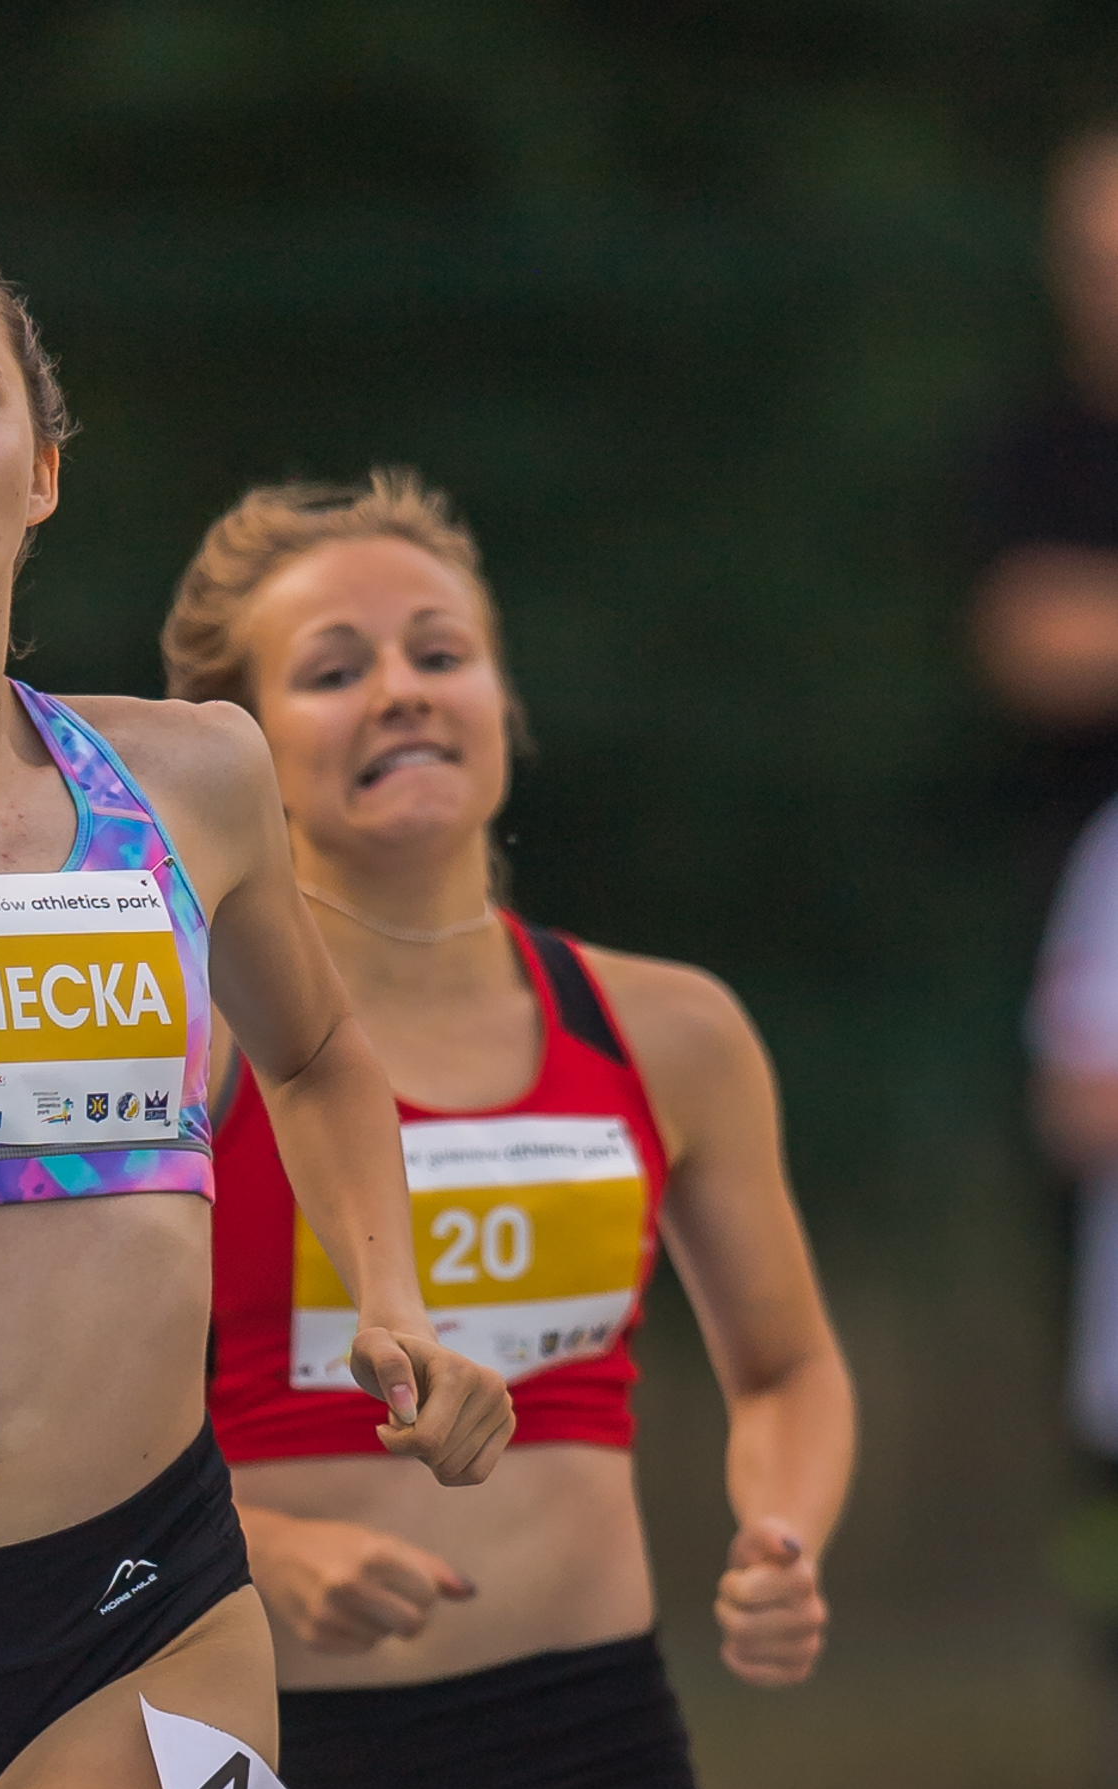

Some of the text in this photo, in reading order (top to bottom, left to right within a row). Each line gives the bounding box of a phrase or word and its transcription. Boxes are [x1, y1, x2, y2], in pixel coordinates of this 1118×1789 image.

[31, 893, 110, 911] athletics
[116, 893, 161, 912] park
[430, 1204, 532, 1284] 20
[99, 1572, 158, 1616] MORE MILE
